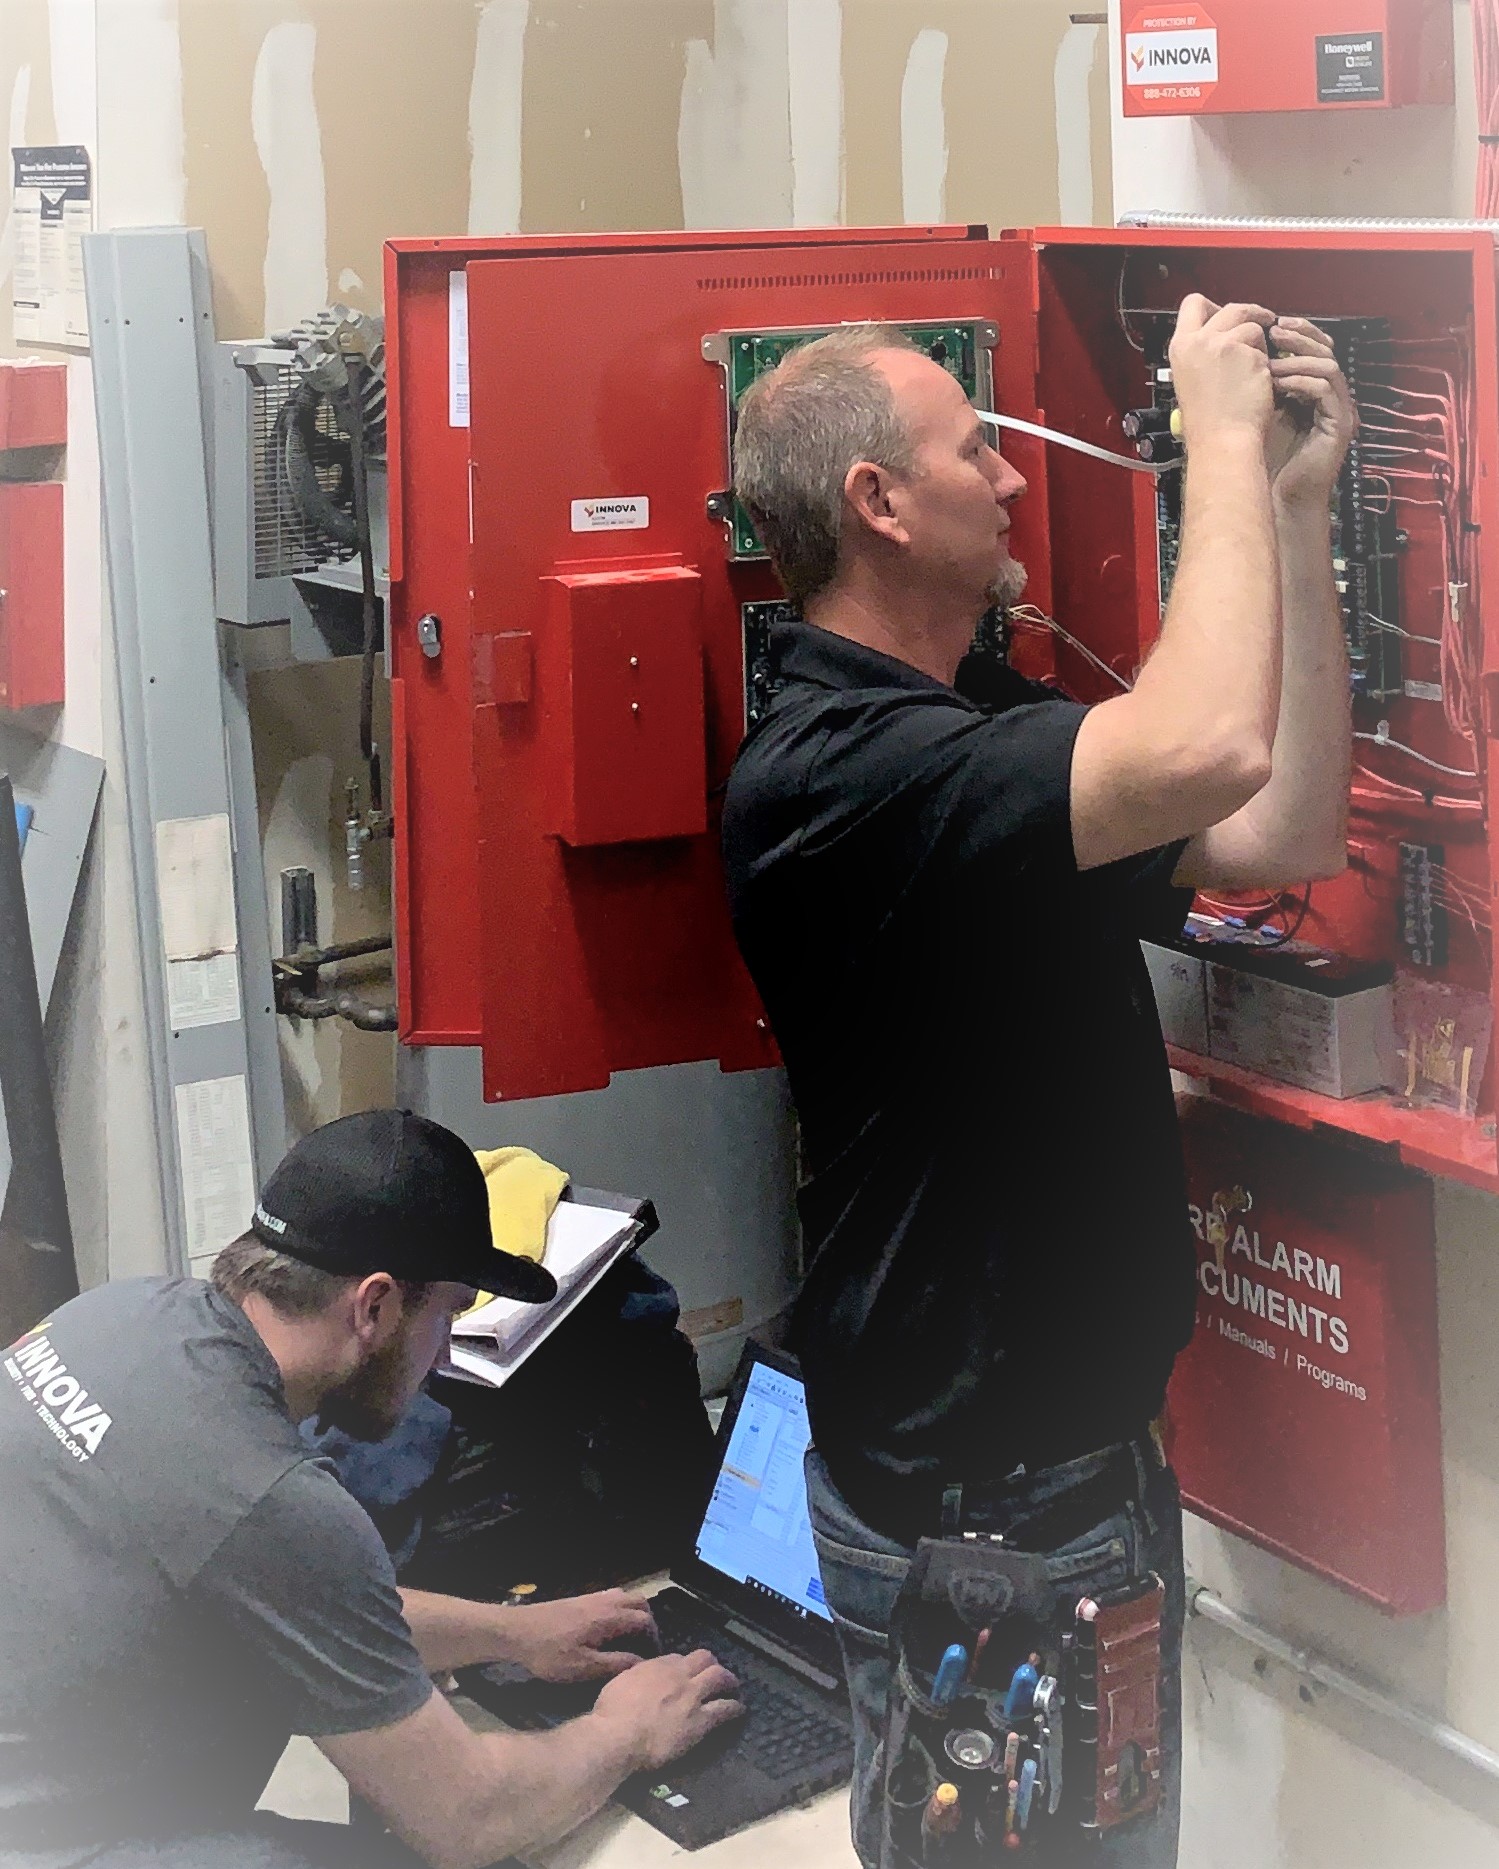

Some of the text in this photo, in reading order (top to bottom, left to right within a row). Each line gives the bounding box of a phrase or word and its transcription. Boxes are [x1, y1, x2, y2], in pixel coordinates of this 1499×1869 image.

[1143, 17, 1186, 27] PROTECTION
[1325, 41, 1372, 55] Honeywell
[1149, 46, 1211, 66] INNOVA
[595, 505, 636, 513] INNOVA
[1232, 1224, 1342, 1300] ALARM
[1198, 1261, 1349, 1354] CUMENTS
[1219, 1317, 1276, 1360] Manuals
[1297, 1354, 1367, 1401] Programs
[14, 1335, 112, 1454] INNOVA
[36, 1404, 90, 1463] TECHNOLOGY
